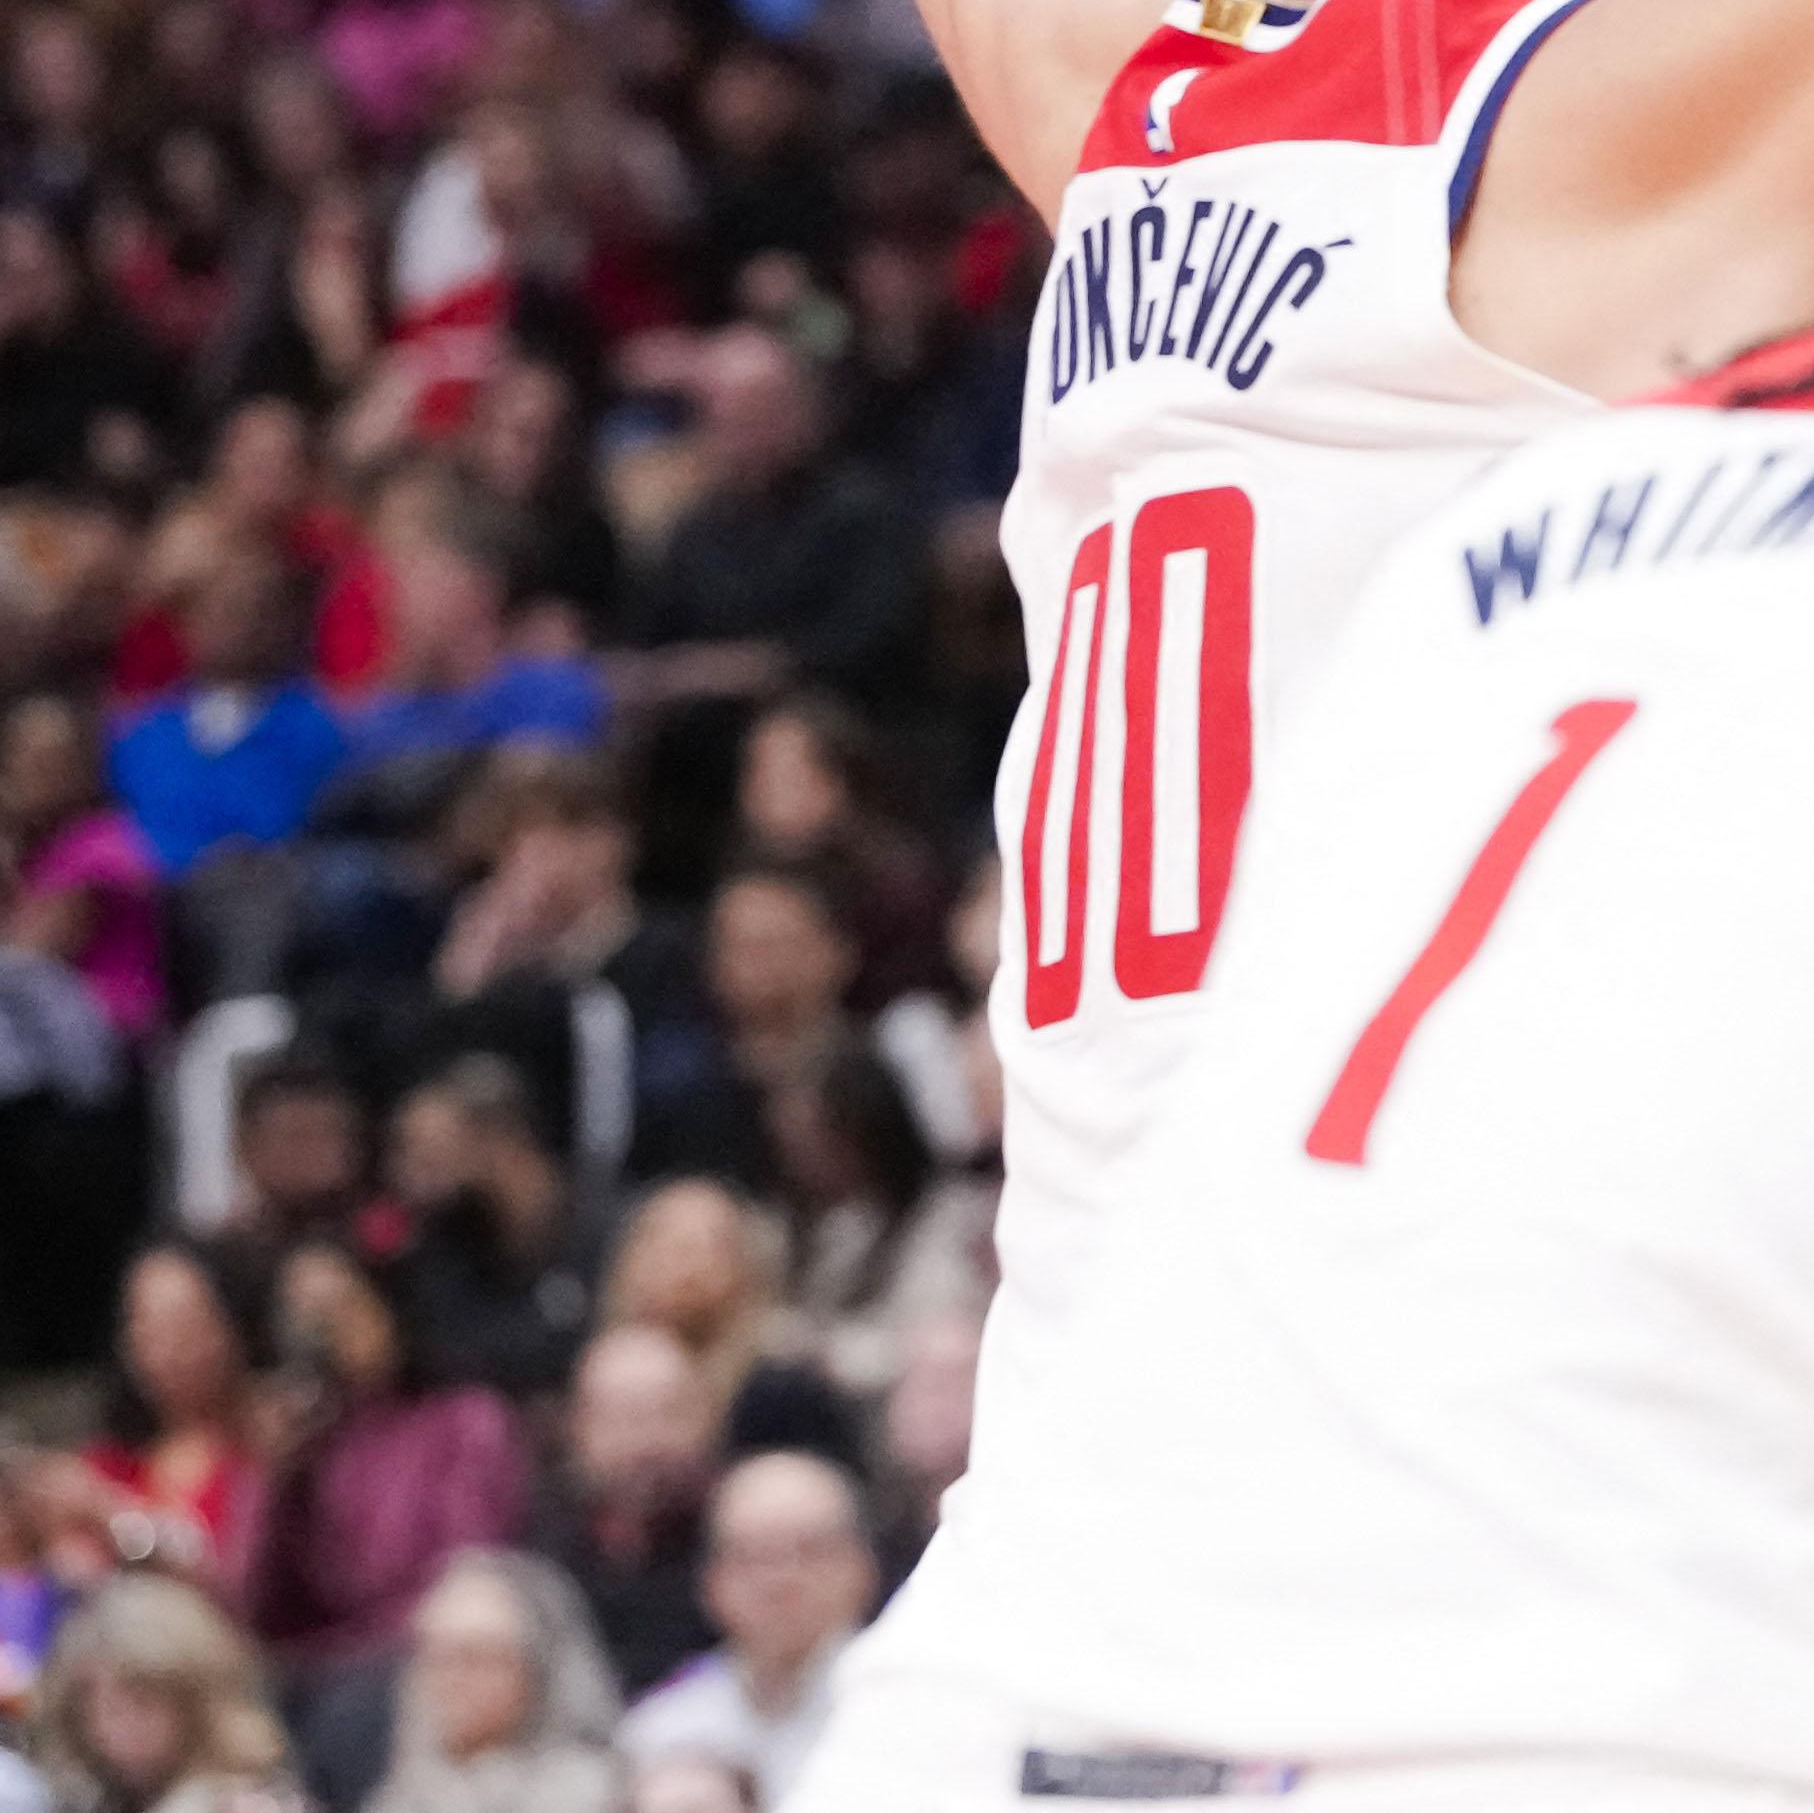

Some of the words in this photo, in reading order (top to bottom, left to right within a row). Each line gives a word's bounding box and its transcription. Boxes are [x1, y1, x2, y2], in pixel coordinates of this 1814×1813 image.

[1051, 176, 1354, 406] UKČEVIĆ
[1021, 485, 1255, 1030] 00
[1305, 697, 1638, 1166] 1
